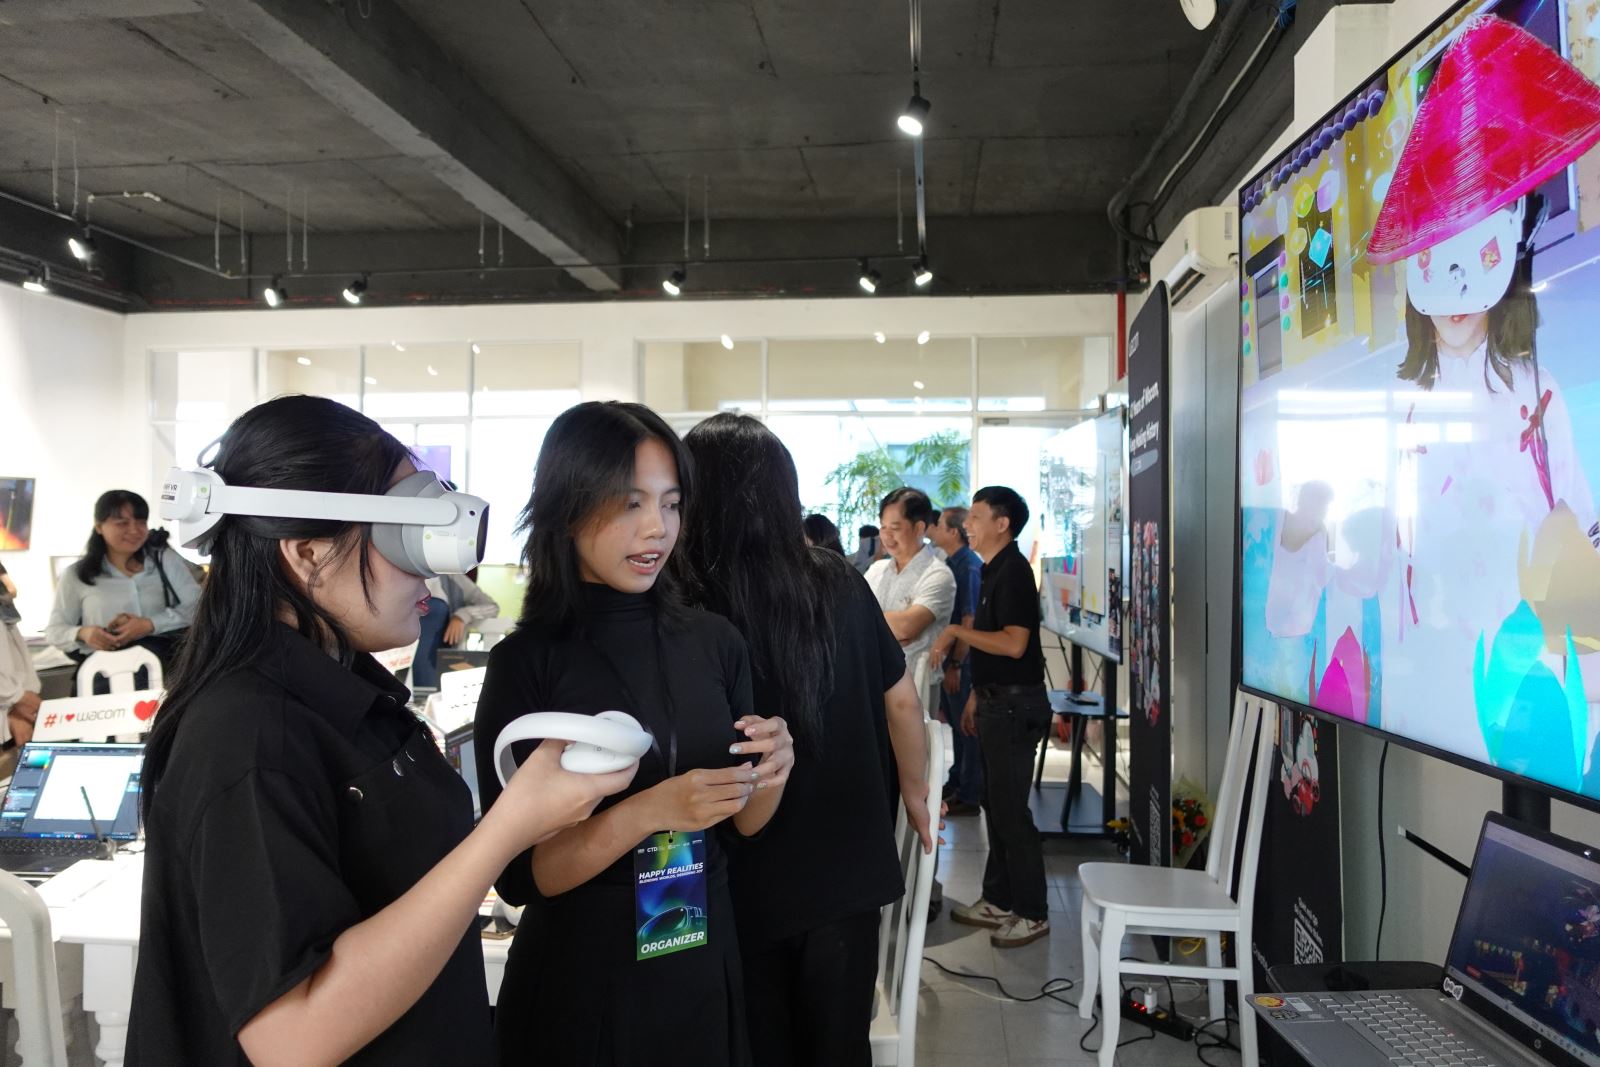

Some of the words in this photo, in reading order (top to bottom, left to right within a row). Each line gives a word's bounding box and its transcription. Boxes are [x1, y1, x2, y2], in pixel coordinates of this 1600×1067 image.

[76, 707, 126, 722] wacom
[638, 869, 666, 879] HAPPY
[667, 862, 704, 874] REALITIES
[640, 931, 705, 954] ORGANIZER
